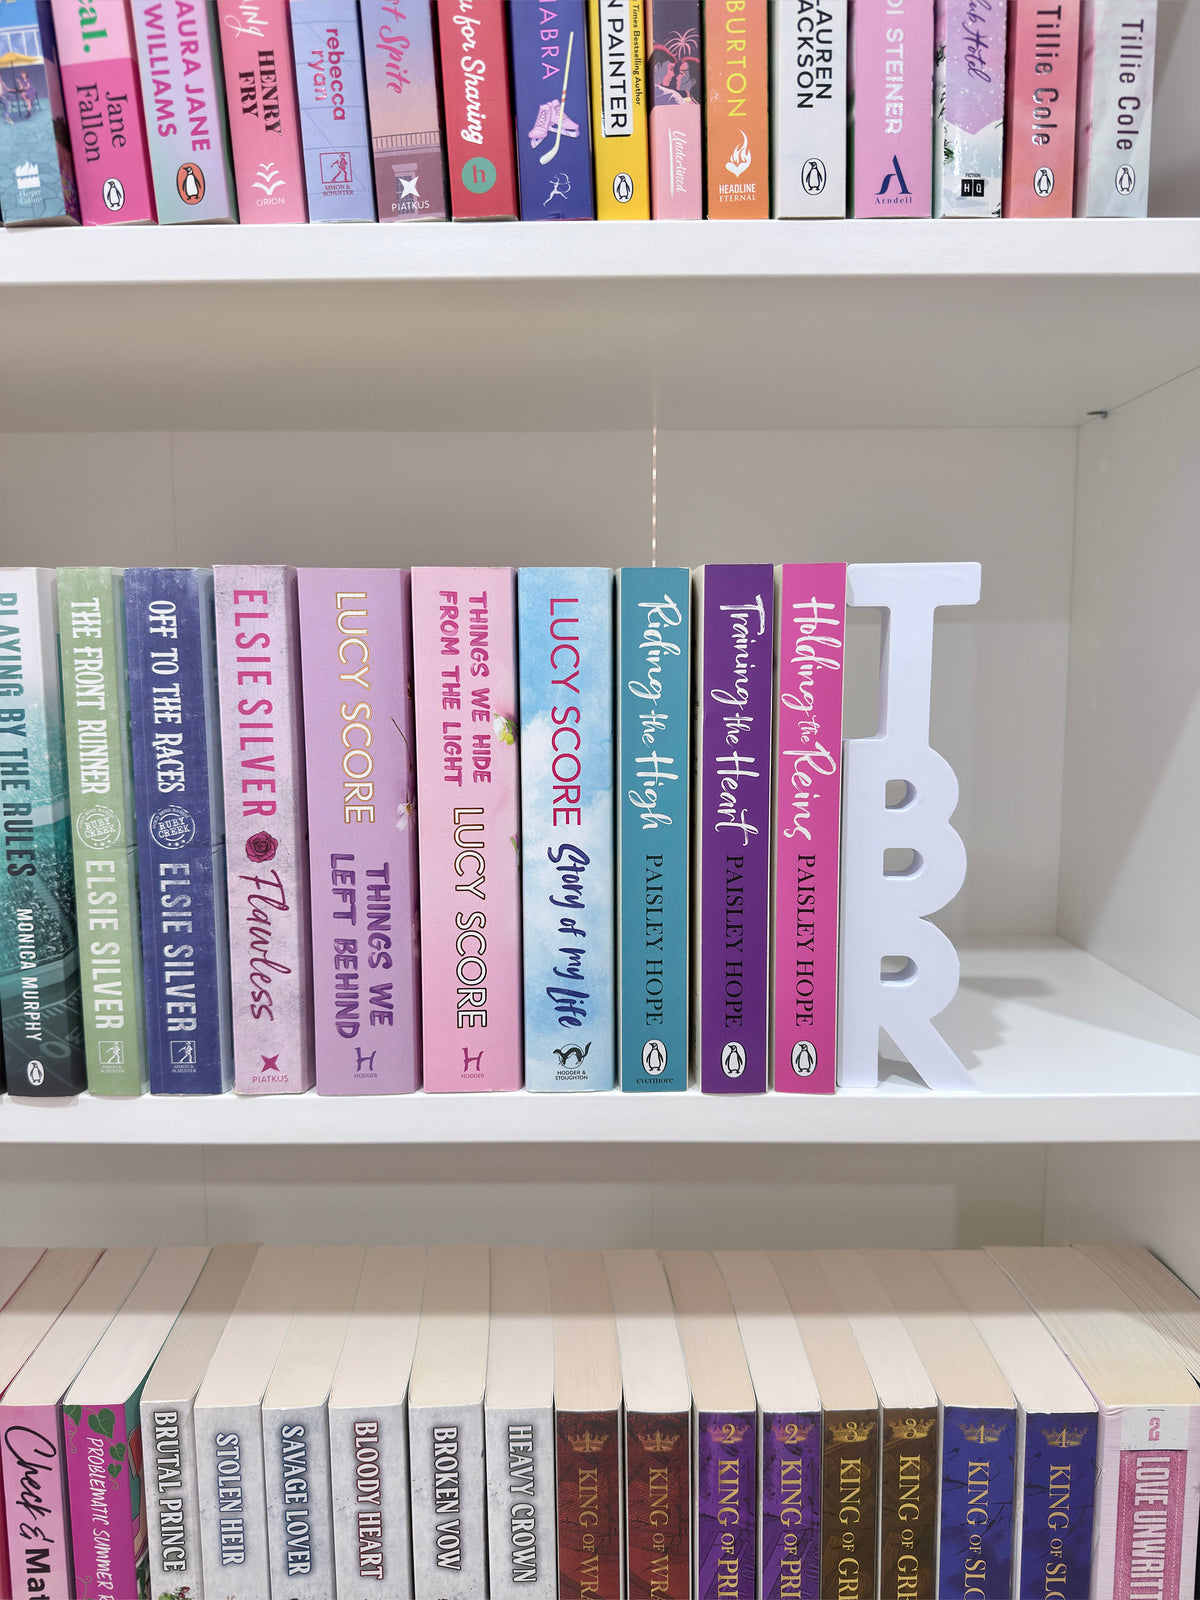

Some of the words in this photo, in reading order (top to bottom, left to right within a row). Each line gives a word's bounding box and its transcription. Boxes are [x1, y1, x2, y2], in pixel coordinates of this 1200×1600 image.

[78, 0, 108, 53] al.
[453, 15, 481, 52] for
[538, 0, 561, 80] ABRA
[632, 5, 640, 28] Times
[1035, 5, 1061, 76] Tillie
[143, 3, 178, 138] WILLIAMS
[307, 50, 327, 101] ryan
[326, 28, 347, 121] rebecca
[376, 25, 411, 95] Spite
[607, 19, 628, 129] PAINTER
[632, 31, 643, 75] Bestselling
[725, 0, 748, 118] BURTON
[884, 28, 905, 134] STEINER
[962, 22, 992, 82] Hotel
[1119, 19, 1144, 84] Tillie
[76, 82, 102, 164] Fallon
[105, 90, 129, 149] Jane
[184, 84, 211, 152] JANE
[238, 71, 259, 119] FRY
[258, 49, 283, 136] HENRY
[460, 55, 487, 145] Sharing
[1031, 87, 1059, 147] Cole
[1116, 97, 1141, 151] Cole
[671, 130, 687, 194] Underlined
[718, 183, 757, 194] HEADLINE
[256, 197, 285, 207] ORION
[391, 200, 430, 212] PIATKUS
[719, 194, 757, 202] ETERNAL
[874, 196, 913, 205] Arndell
[70, 597, 102, 639] THE
[148, 600, 178, 639] OFF
[233, 589, 272, 686] ELSIE
[335, 591, 371, 690] LUCY
[439, 590, 460, 656] FROM
[469, 591, 490, 678] THINGS
[550, 598, 581, 694] LUCY
[628, 594, 683, 706] Riding
[73, 646, 106, 710] FRONT
[150, 648, 180, 675] TO
[710, 594, 766, 711] Training
[781, 596, 843, 717] Holding
[152, 683, 182, 724] THE
[441, 665, 461, 710] THE
[471, 687, 490, 723] WE
[0, 708, 27, 737] BY
[442, 722, 463, 788] LIGHT
[638, 710, 669, 747] the
[723, 712, 754, 748] the
[797, 714, 821, 743] the
[1, 748, 31, 791] THE
[77, 719, 111, 795] RUNNER
[152, 733, 186, 793] RACES
[238, 699, 277, 817] SILVER
[340, 702, 375, 824] SCORE
[472, 734, 492, 784] HIDE
[550, 706, 582, 827] SCORE
[628, 750, 680, 830] High
[84, 817, 111, 831] RUBY
[158, 817, 186, 831] RUBY
[714, 751, 761, 846] Heart
[782, 741, 837, 842] Reins
[2, 802, 37, 877] RULES
[84, 824, 116, 839] CREEK
[158, 824, 191, 839] CREEK
[453, 807, 486, 900] LUCY
[837, 562, 981, 1090] TBR
[86, 860, 119, 931] ELSIE
[159, 863, 193, 933] ELSIE
[330, 853, 357, 926] LEFT
[547, 842, 591, 910] Story
[645, 854, 664, 953] PAISLEY
[726, 855, 744, 953] PAISLEY
[796, 854, 816, 953] PAISLEY
[16, 908, 37, 970] MONICA
[238, 869, 292, 1022] Flawless
[366, 862, 393, 970] THINGS
[557, 917, 587, 938] of
[90, 941, 125, 1029] SILVER
[163, 945, 197, 1032] SILVER
[334, 938, 360, 1039] BEHIND
[455, 912, 488, 1029] SCORE
[552, 947, 586, 981] my
[645, 960, 664, 1026] HOPE
[725, 960, 743, 1028] HOPE
[795, 959, 814, 1027] HOPE
[21, 977, 43, 1041] MURPHY
[369, 982, 394, 1027] WE
[252, 1075, 289, 1083] PIATKUS
[636, 1077, 674, 1085] evermore
[153, 1410, 183, 1493] BRUTAL
[508, 1424, 535, 1496] HEAVY
[722, 1424, 735, 1444] 2
[785, 1424, 798, 1444] 2
[846, 1421, 857, 1443] 3
[905, 1418, 917, 1439] 3
[975, 1423, 987, 1444] 4
[1056, 1428, 1068, 1448] 4
[4, 1425, 57, 1521] Check
[86, 1436, 109, 1526] PROBLEMATIC
[215, 1432, 243, 1512] STOLEN
[281, 1423, 309, 1504] SAVAGE
[354, 1420, 381, 1507] BLOODY
[433, 1425, 460, 1514] BROKEN
[717, 1458, 740, 1527] KING
[780, 1458, 802, 1527] KING
[838, 1457, 861, 1525] KING
[897, 1453, 921, 1522] KING
[966, 1460, 990, 1527] KING
[1135, 1456, 1172, 1506] LOVE
[578, 1467, 598, 1527] KING
[649, 1467, 669, 1527] KING
[1047, 1464, 1071, 1531] KING
[19, 1522, 55, 1544] &
[92, 1529, 114, 1590] SUMMER
[159, 1498, 188, 1572] PRINCE
[220, 1518, 245, 1566] HEIR
[285, 1509, 311, 1576] LOVER
[358, 1511, 384, 1580] HEART
[435, 1519, 462, 1571] VOW
[510, 1502, 538, 1584] CROWN
[582, 1533, 595, 1553] OF
[652, 1532, 665, 1552] OF
[721, 1533, 735, 1555] OF
[783, 1533, 798, 1555] OF
[842, 1531, 856, 1553] OF
[902, 1528, 917, 1550] OF
[969, 1534, 982, 1555] OF
[1050, 1538, 1063, 1558] OF
